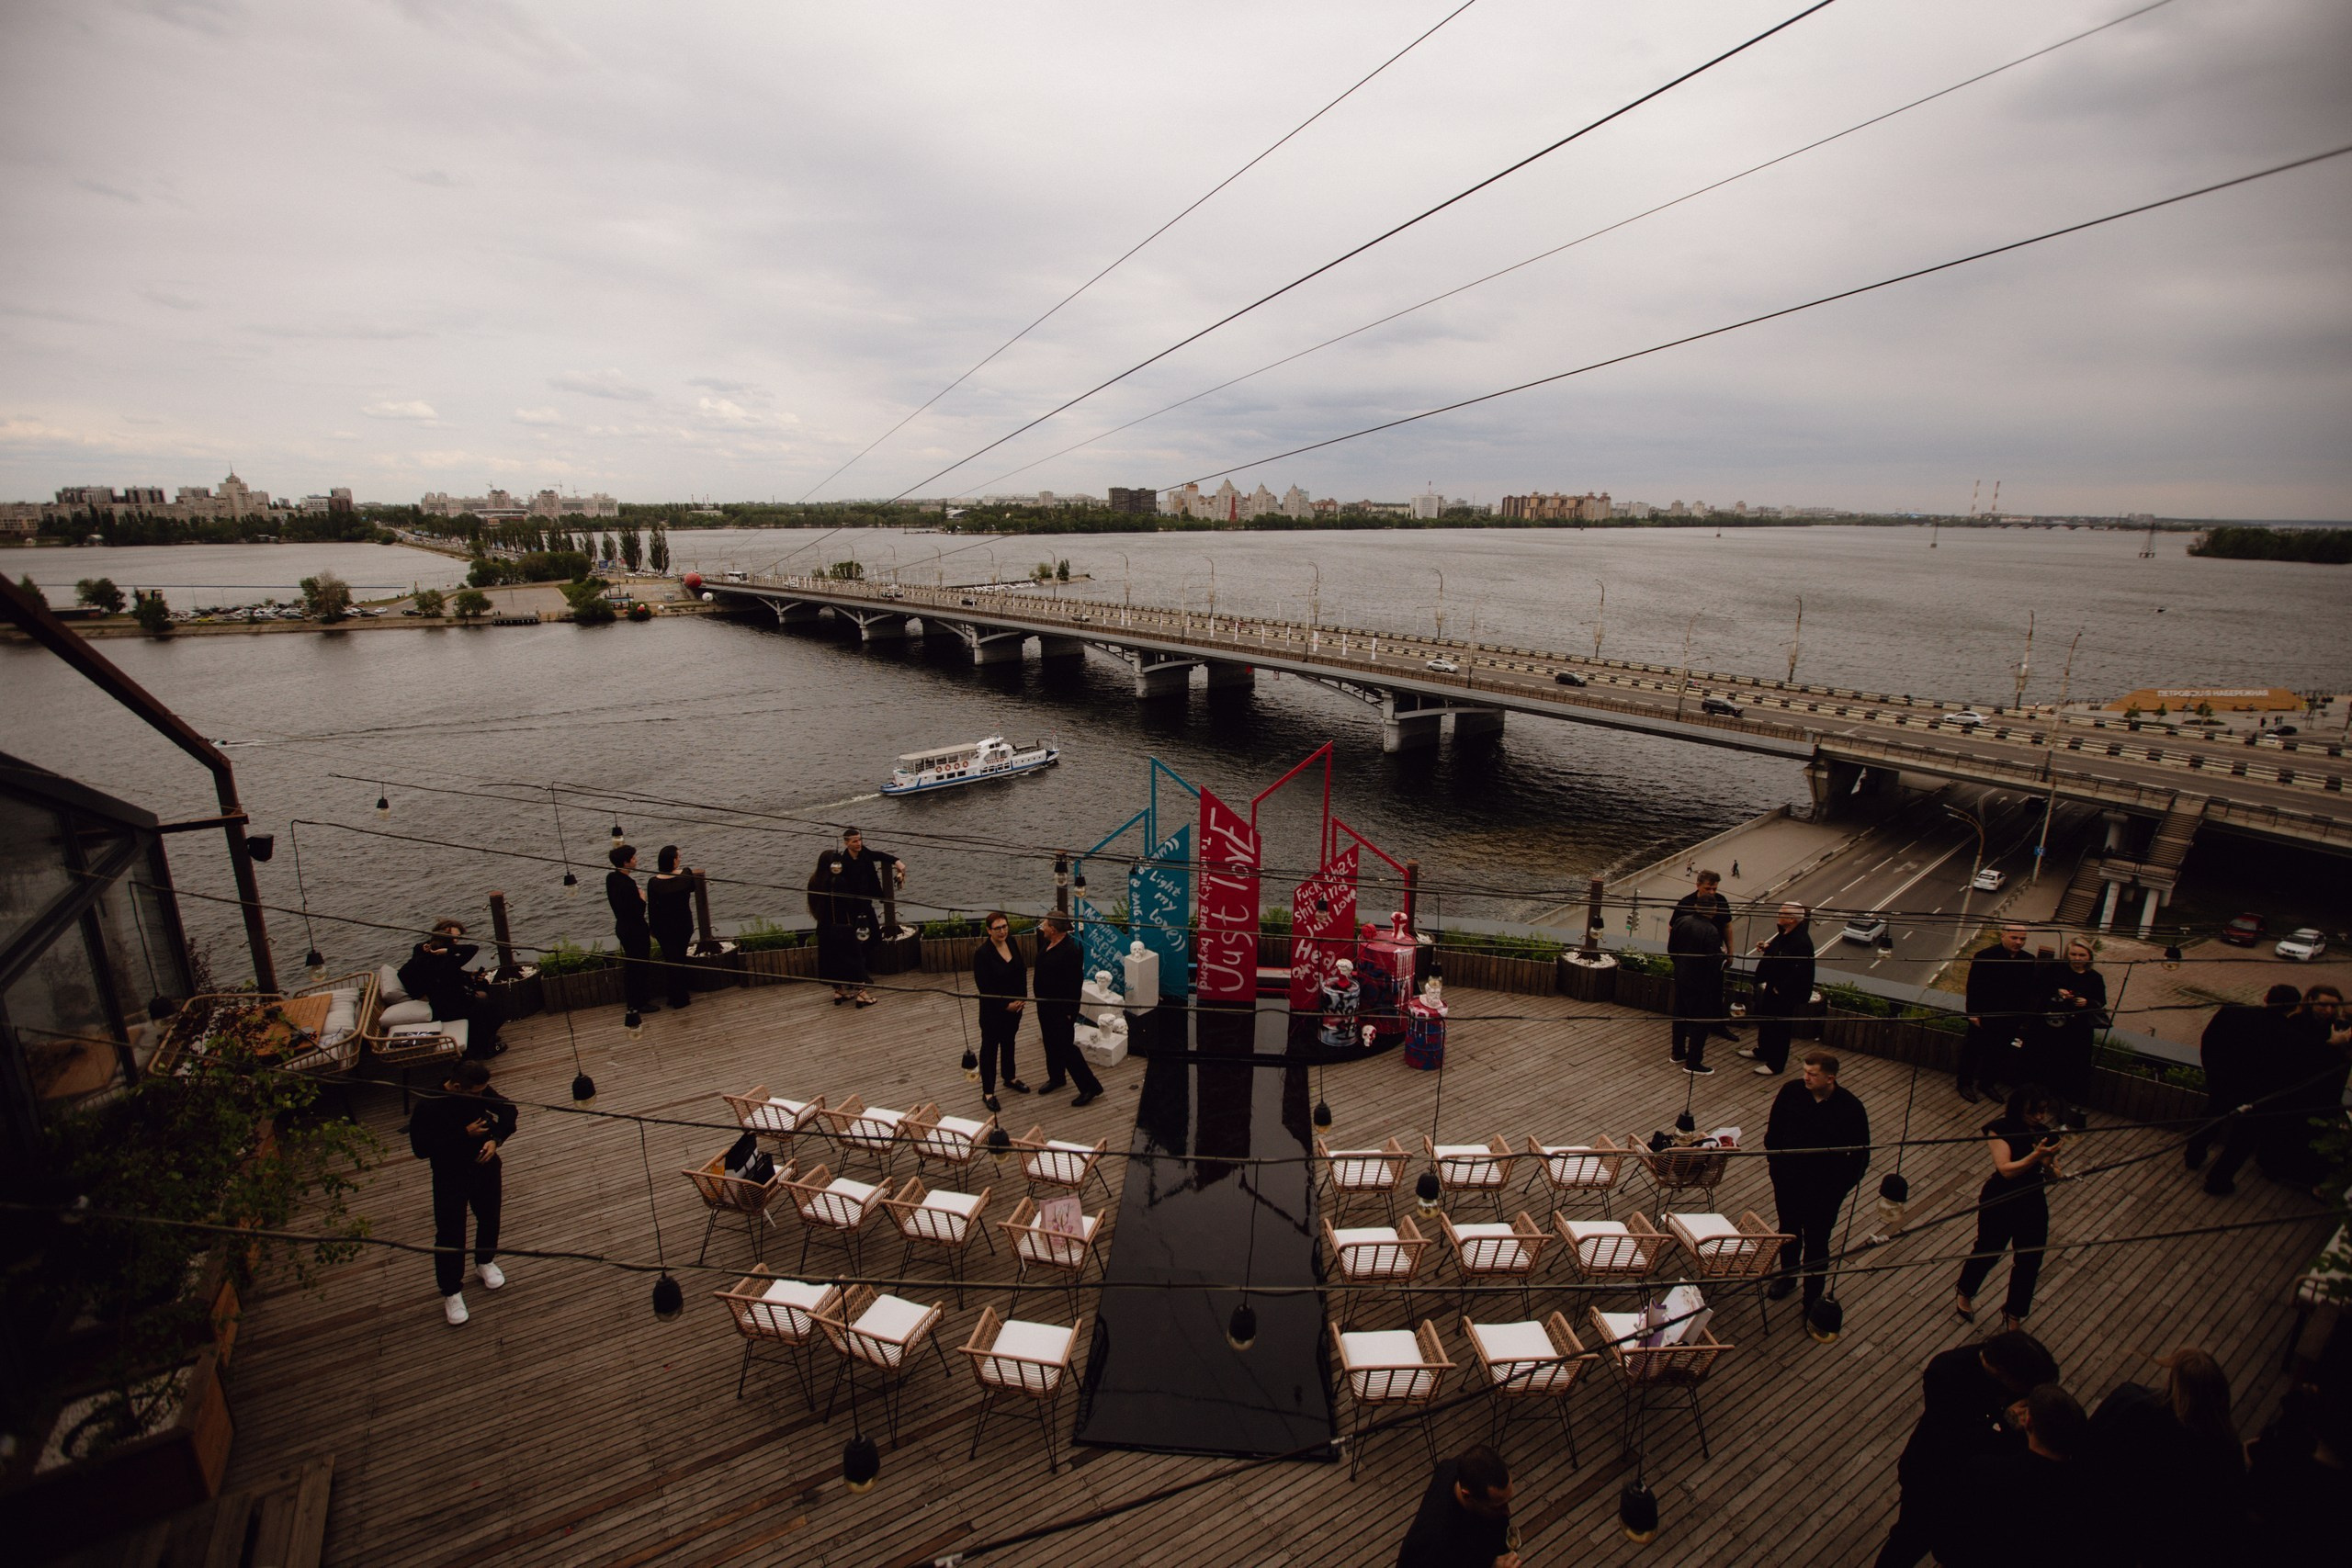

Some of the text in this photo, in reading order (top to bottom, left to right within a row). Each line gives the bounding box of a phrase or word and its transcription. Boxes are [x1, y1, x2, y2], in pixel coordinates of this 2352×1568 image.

[1149, 870, 1182, 897] Light
[1295, 853, 1357, 902] Fuck that
[1129, 893, 1143, 917] give
[1154, 892, 1178, 911] my
[1295, 897, 1317, 924] shit
[1198, 906, 1210, 931] and
[1206, 904, 1253, 992] Just
[1091, 948, 1125, 983] withou
[1197, 937, 1214, 991] beyond
